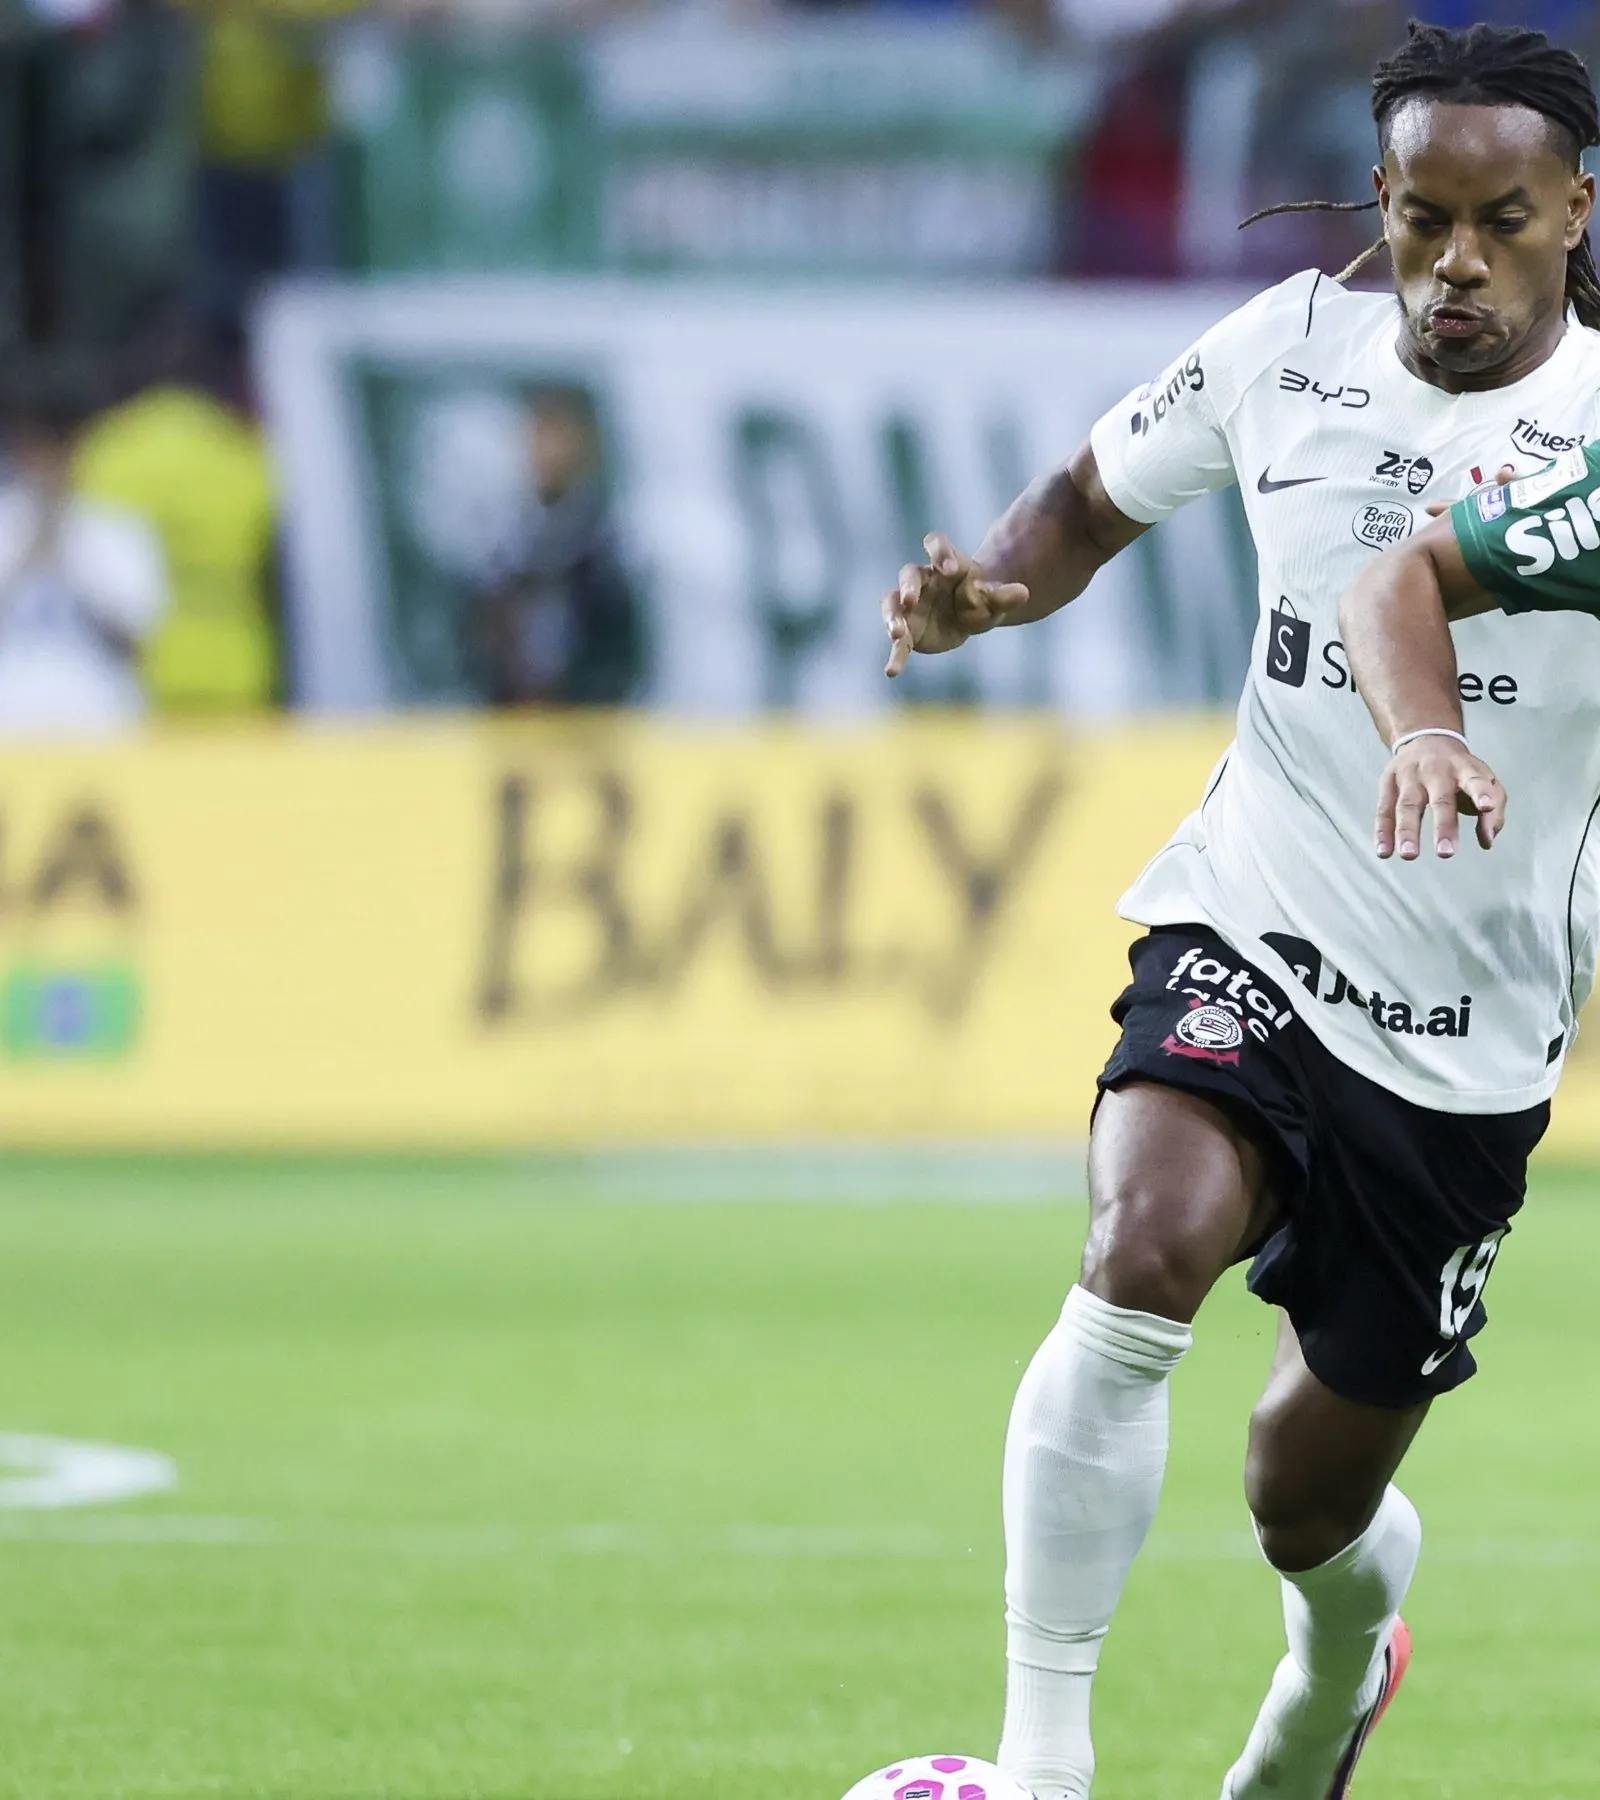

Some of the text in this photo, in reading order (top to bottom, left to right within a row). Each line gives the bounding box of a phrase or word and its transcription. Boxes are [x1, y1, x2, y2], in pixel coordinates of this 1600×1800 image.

[1153, 350, 1205, 423] bmg
[1279, 367, 1371, 409] BYD
[1361, 522, 1406, 544] Legal
[1363, 506, 1408, 526] Broto
[1320, 640, 1518, 705] See
[1169, 947, 1294, 1031] fatal
[1439, 1227, 1506, 1341] 19
